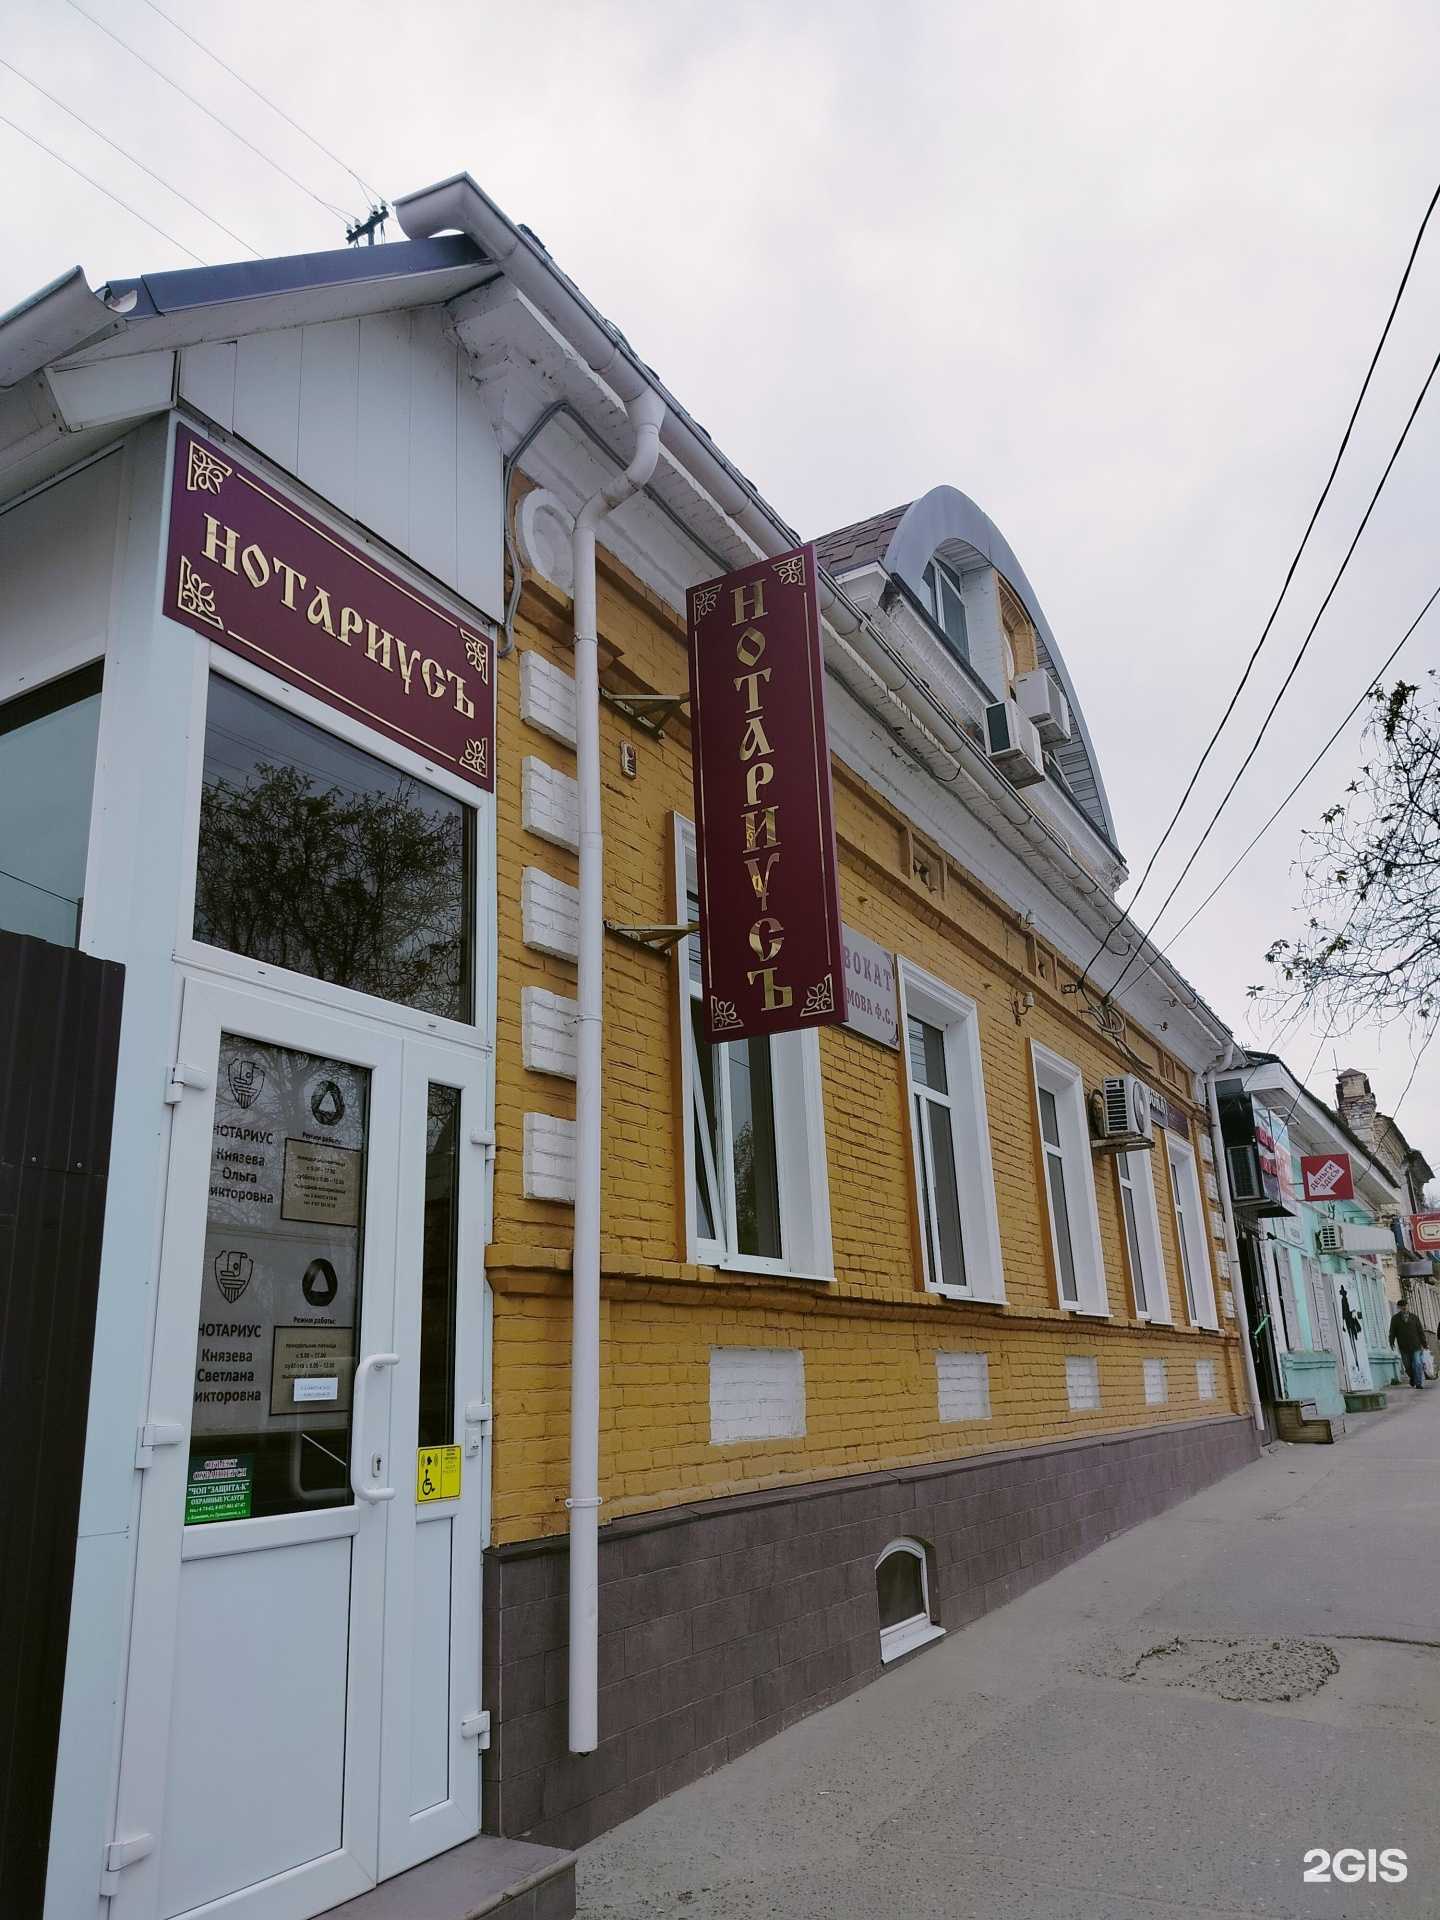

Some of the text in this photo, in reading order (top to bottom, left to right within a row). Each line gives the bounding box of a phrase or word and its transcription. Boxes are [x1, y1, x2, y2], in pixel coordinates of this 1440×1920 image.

[842, 947, 891, 992] ВОКАТ
[846, 987, 873, 1016] МОВА
[216, 1147, 266, 1167] Князева
[222, 1167, 257, 1184] Ольга
[1311, 1163, 1335, 1190] ДЕНЬГИ
[209, 1186, 274, 1204] икторовна
[201, 1348, 254, 1363] Князева
[197, 1368, 255, 1382] Светлана
[194, 1390, 262, 1405] икторовна
